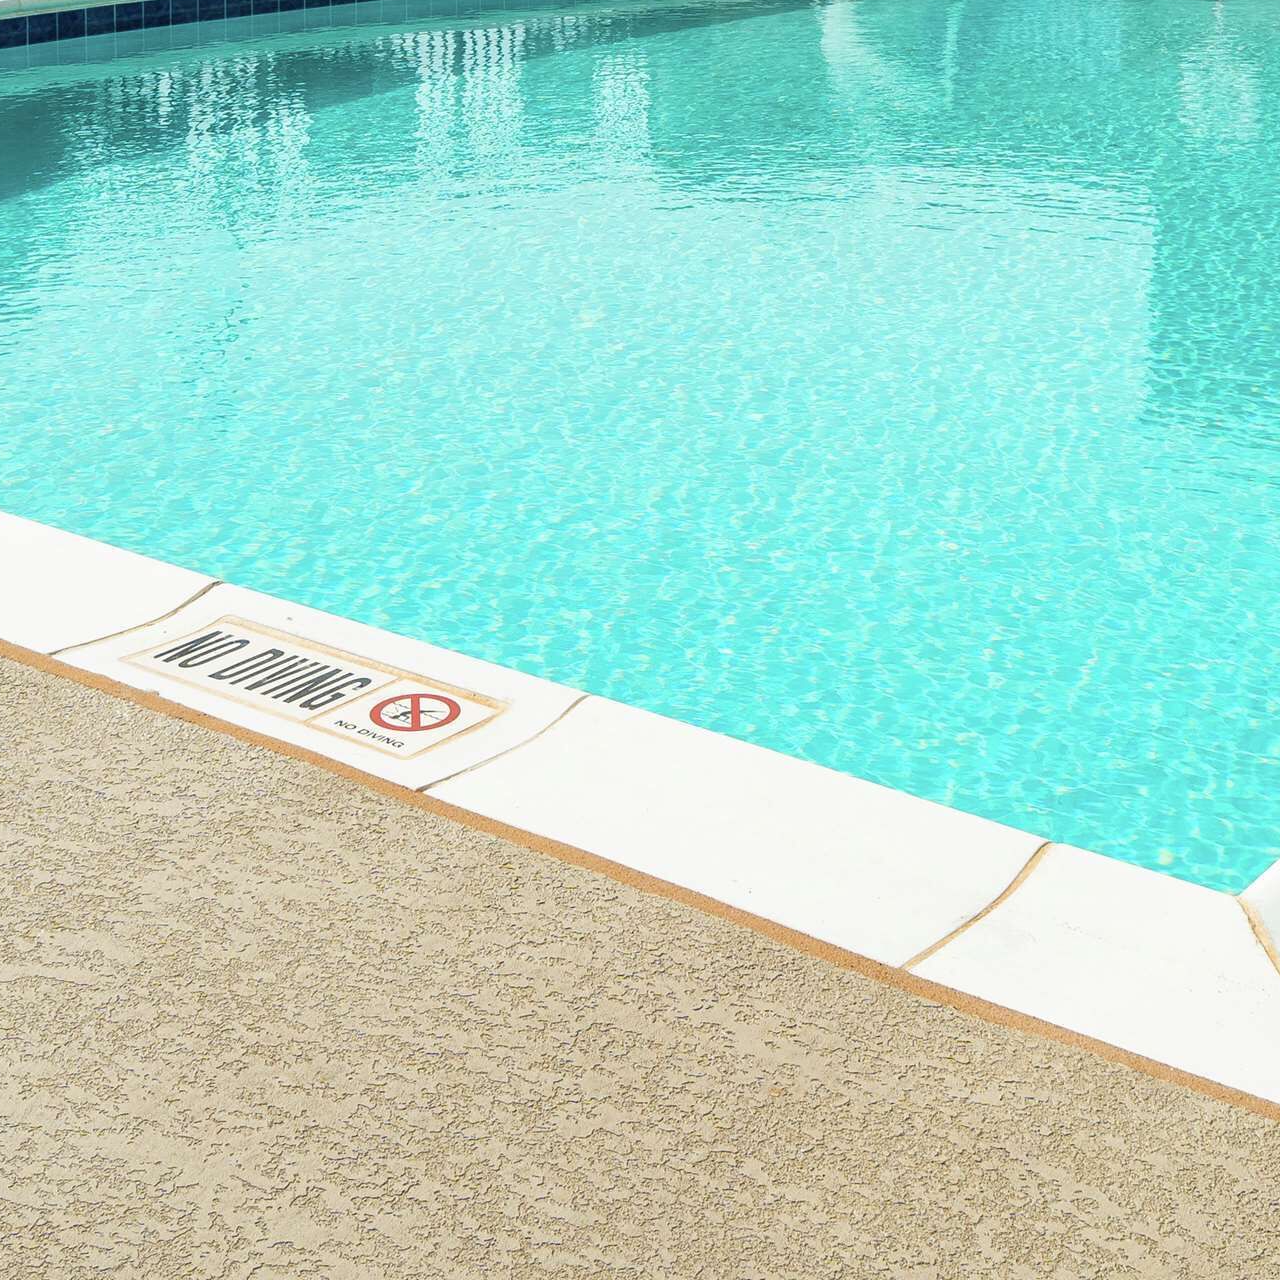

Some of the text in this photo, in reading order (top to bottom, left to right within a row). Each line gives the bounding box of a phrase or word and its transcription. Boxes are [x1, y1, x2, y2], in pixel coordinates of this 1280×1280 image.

[153, 630, 372, 711] NO DIVING
[334, 720, 405, 749] NO DIVING
